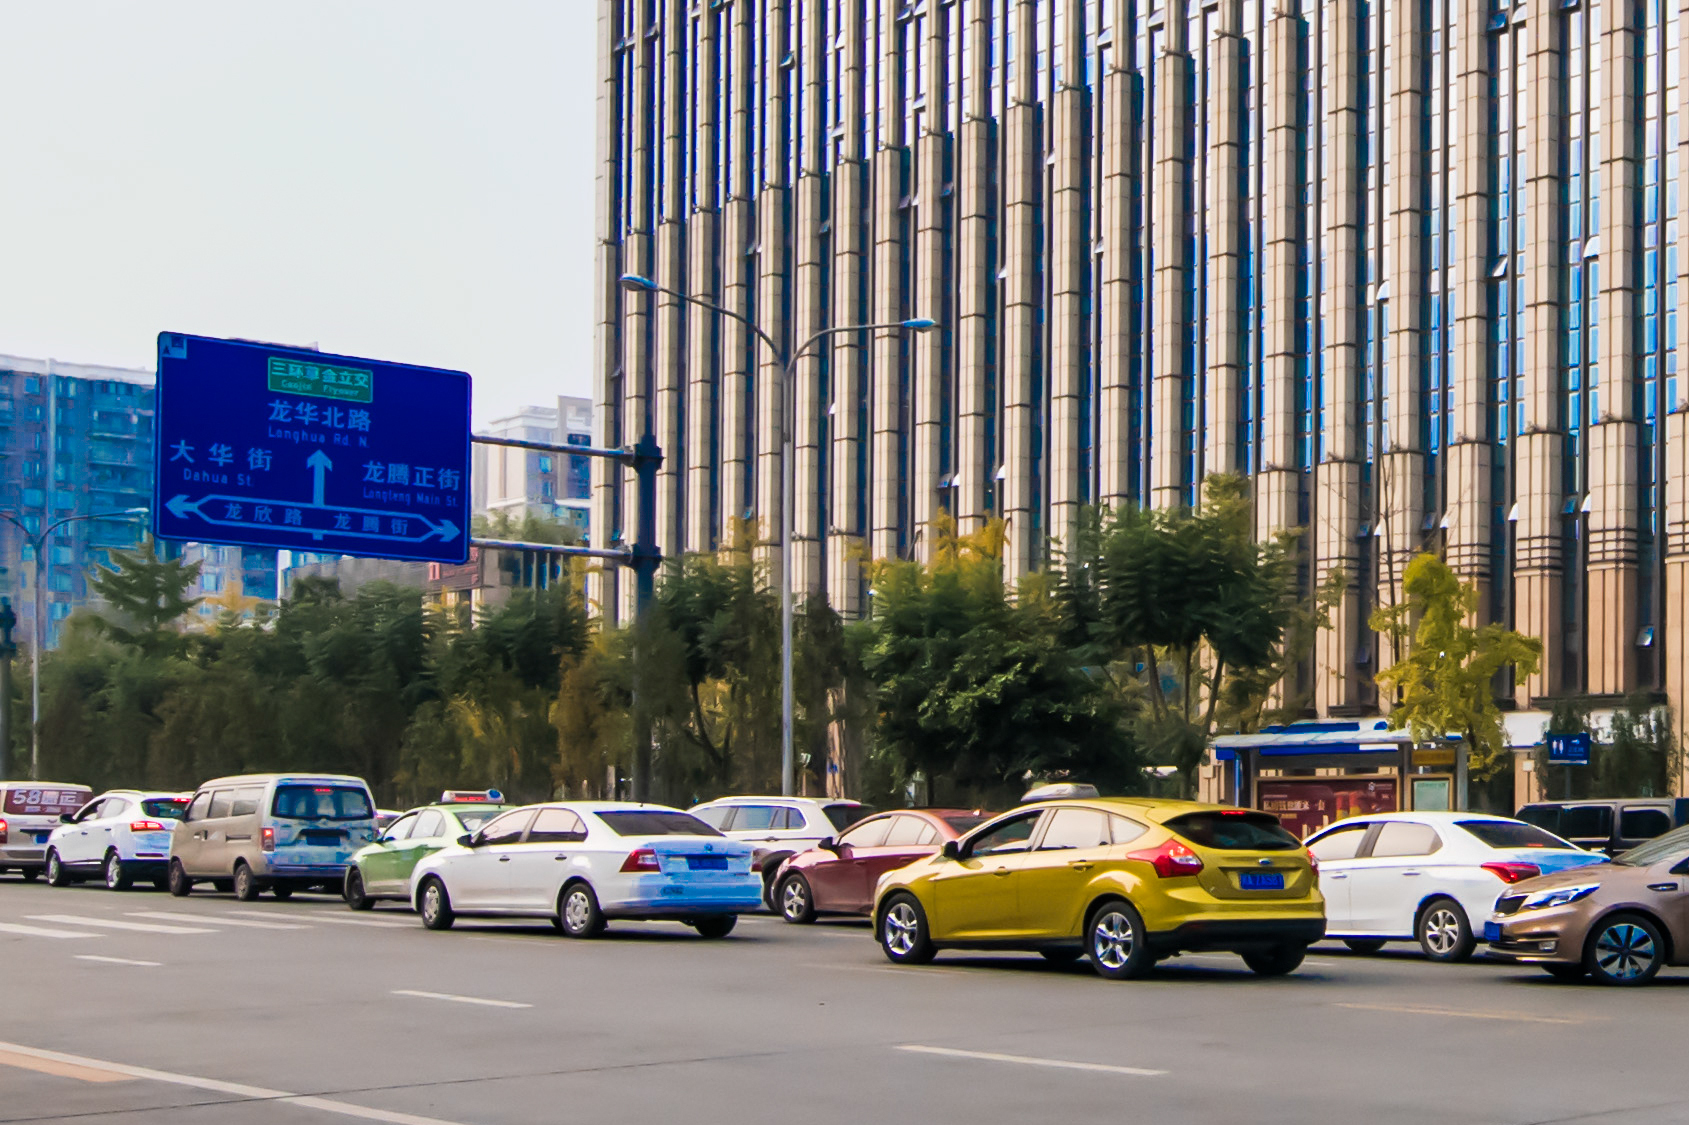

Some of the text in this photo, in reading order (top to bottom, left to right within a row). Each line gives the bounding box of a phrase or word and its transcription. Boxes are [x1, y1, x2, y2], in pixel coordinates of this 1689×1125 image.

[267, 399, 372, 432] 龙华北路
[268, 424, 326, 444] Longhua
[169, 439, 273, 472] 大华街
[183, 467, 229, 485] Dahua
[362, 460, 461, 491] 龙腾正街
[223, 502, 304, 526] 龙欣路
